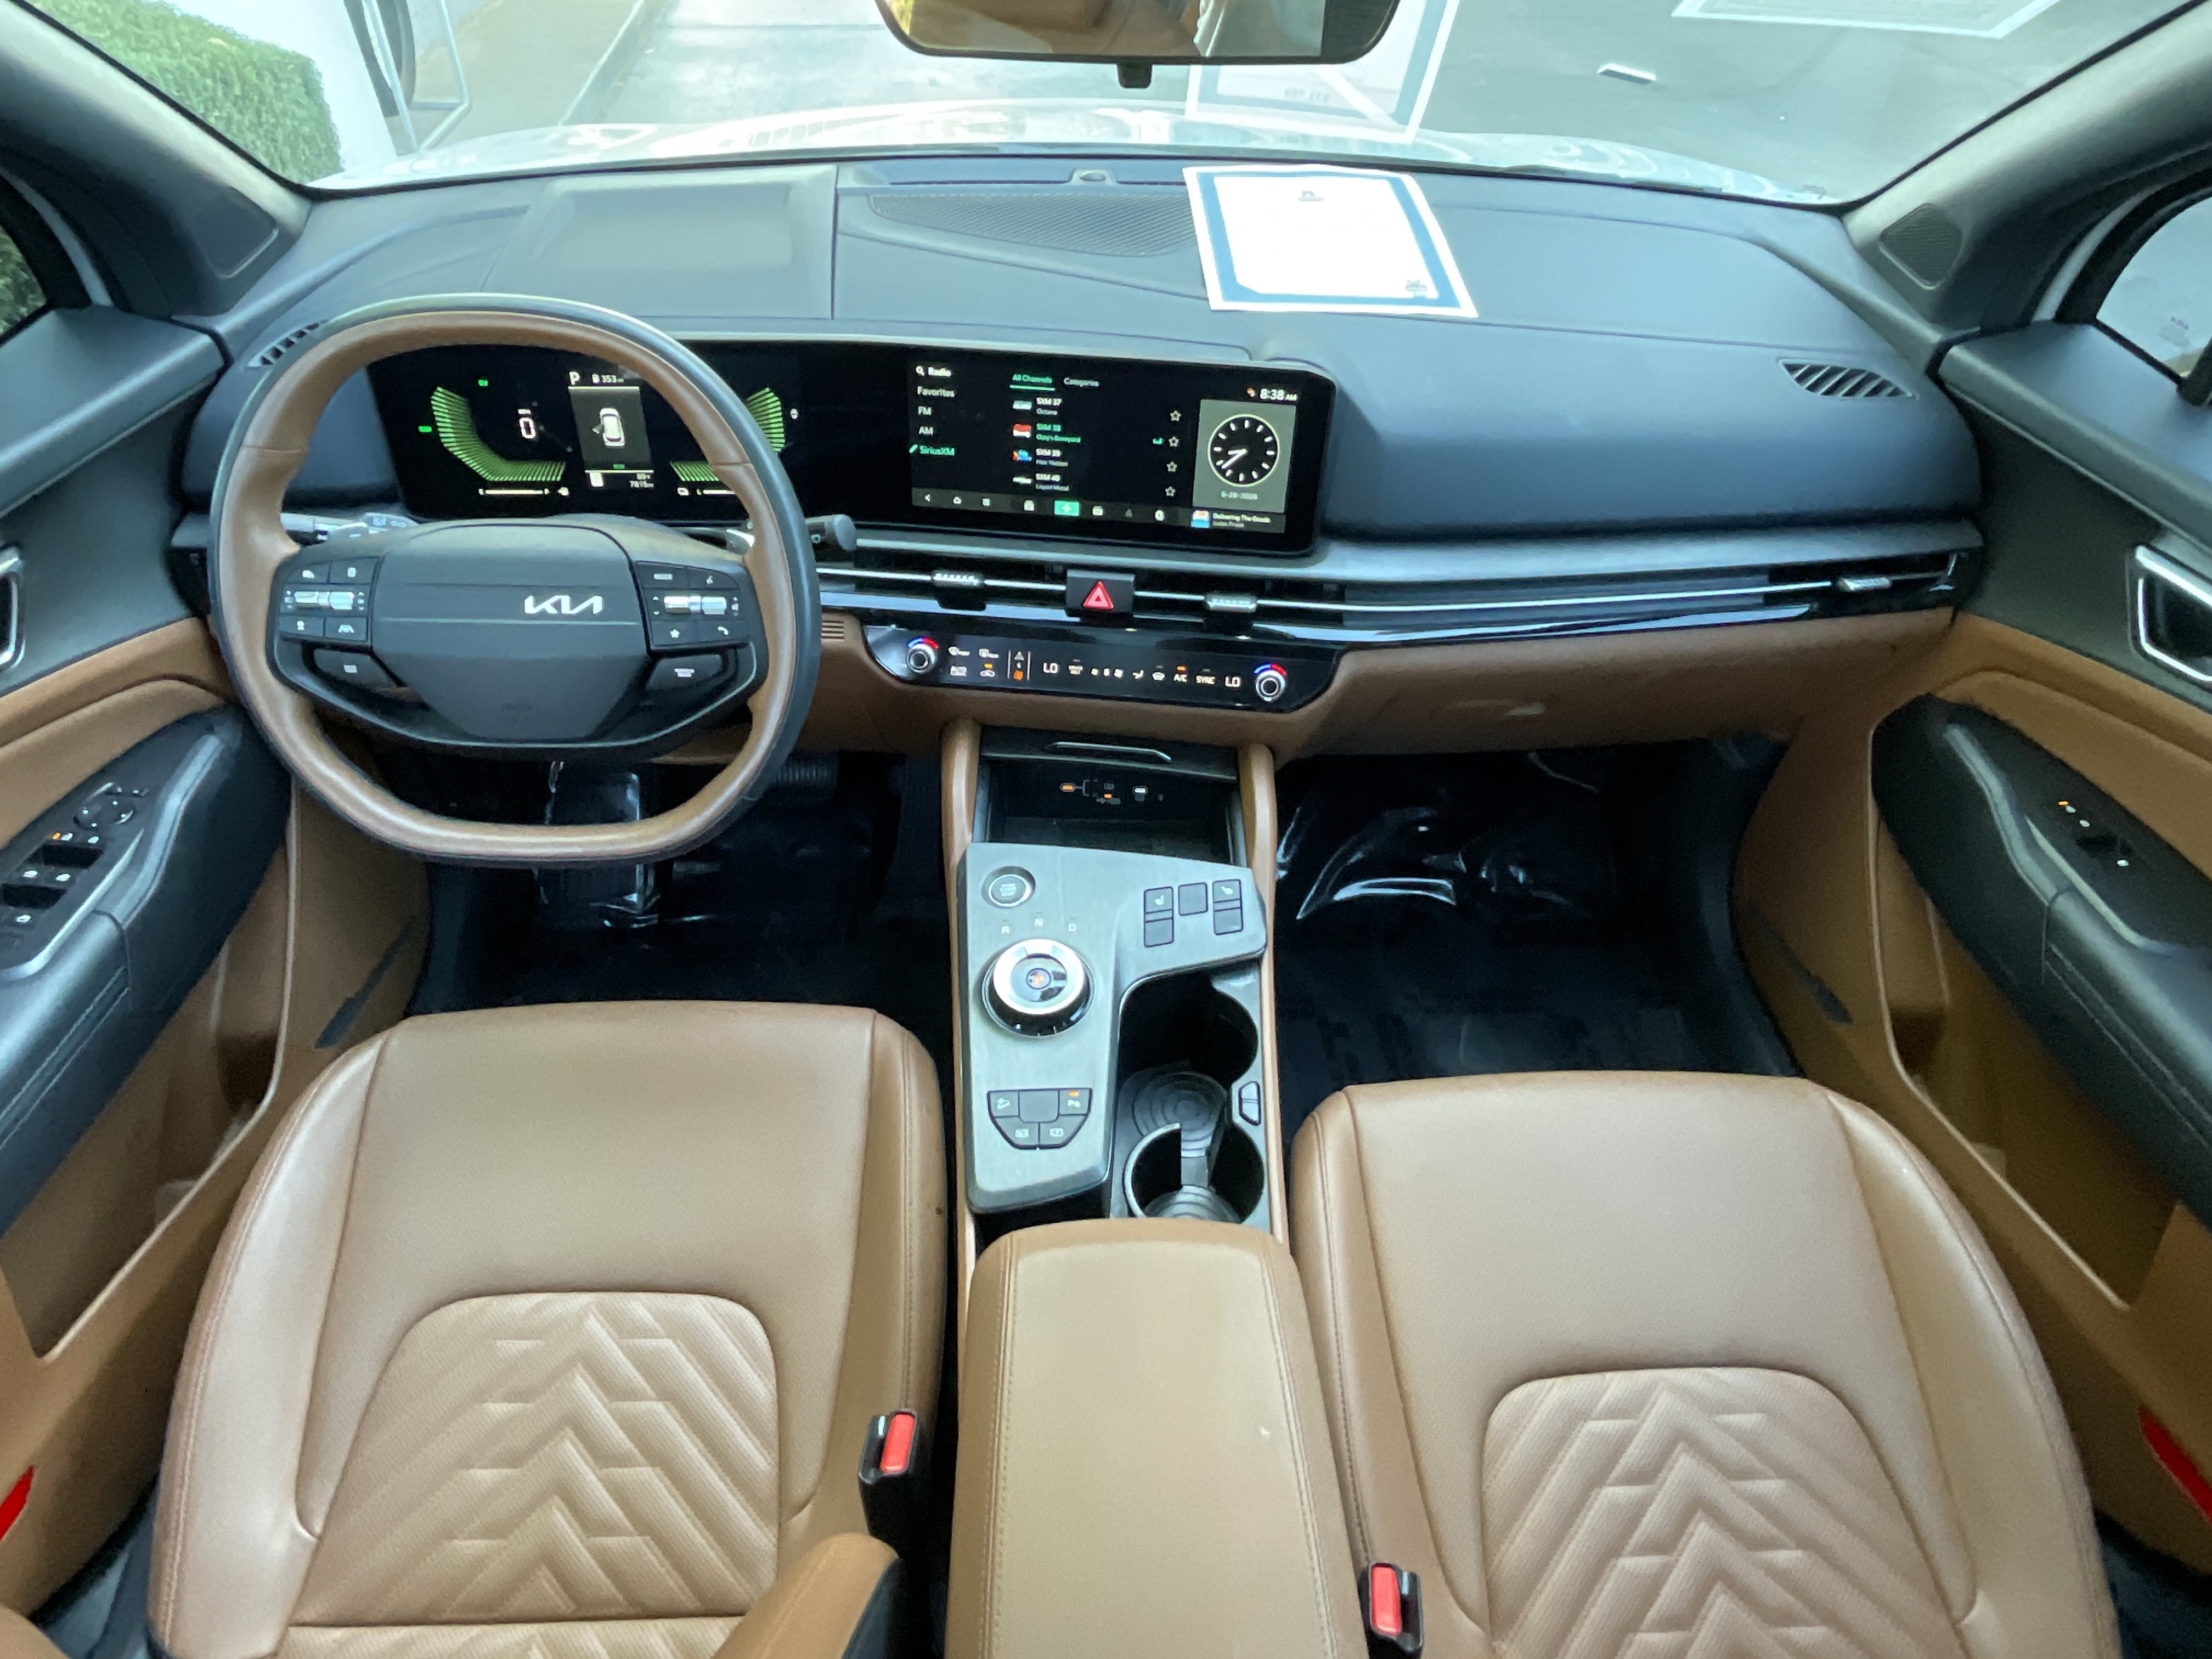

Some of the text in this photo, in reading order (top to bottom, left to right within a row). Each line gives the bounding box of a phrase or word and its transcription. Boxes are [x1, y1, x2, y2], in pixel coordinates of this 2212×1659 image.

[928, 366, 951, 377] Radio
[569, 371, 580, 385] P
[917, 386, 955, 398] Favorites
[1260, 388, 1284, 400] 8:38
[918, 406, 932, 416] FM
[520, 417, 536, 439] 0
[919, 426, 934, 436] AM
[1042, 662, 1058, 674] LO
[1173, 673, 1187, 682] A/C
[1224, 675, 1241, 687] LO
